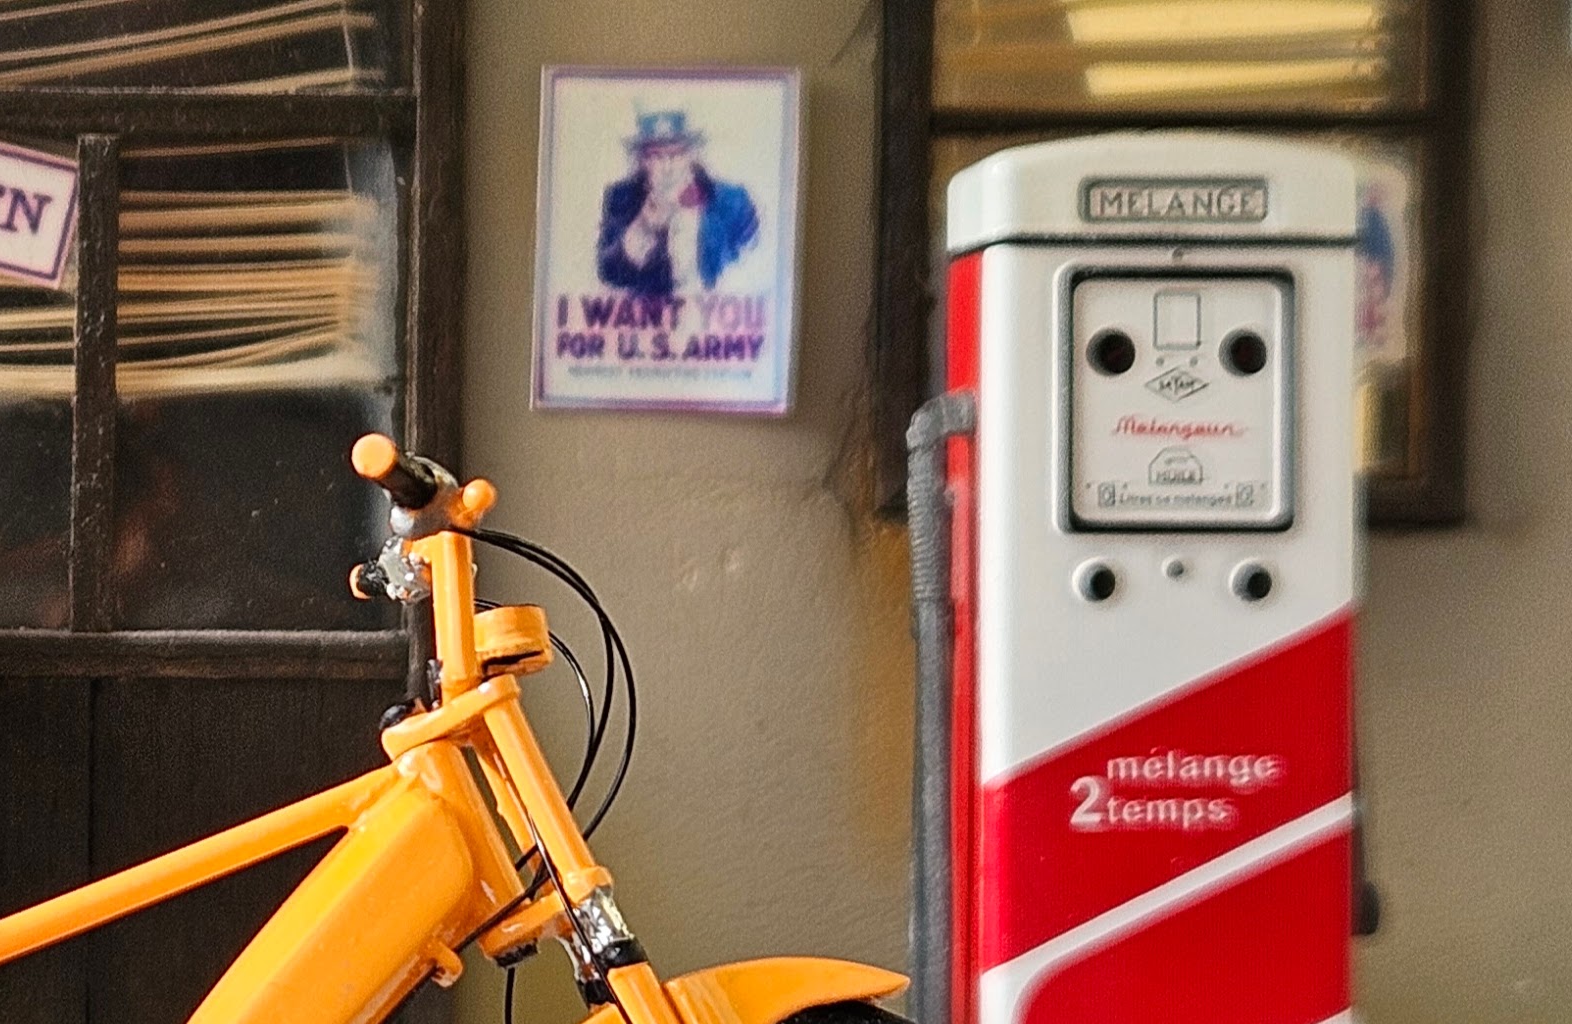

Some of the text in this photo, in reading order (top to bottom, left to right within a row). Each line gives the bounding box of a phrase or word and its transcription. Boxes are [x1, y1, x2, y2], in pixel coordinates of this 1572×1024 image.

[1099, 184, 1261, 217] MELANGE
[556, 294, 765, 331] I WANT YOU
[556, 332, 605, 359] FOR
[1107, 747, 1280, 793] mélange
[1069, 775, 1234, 831] 2 temps
